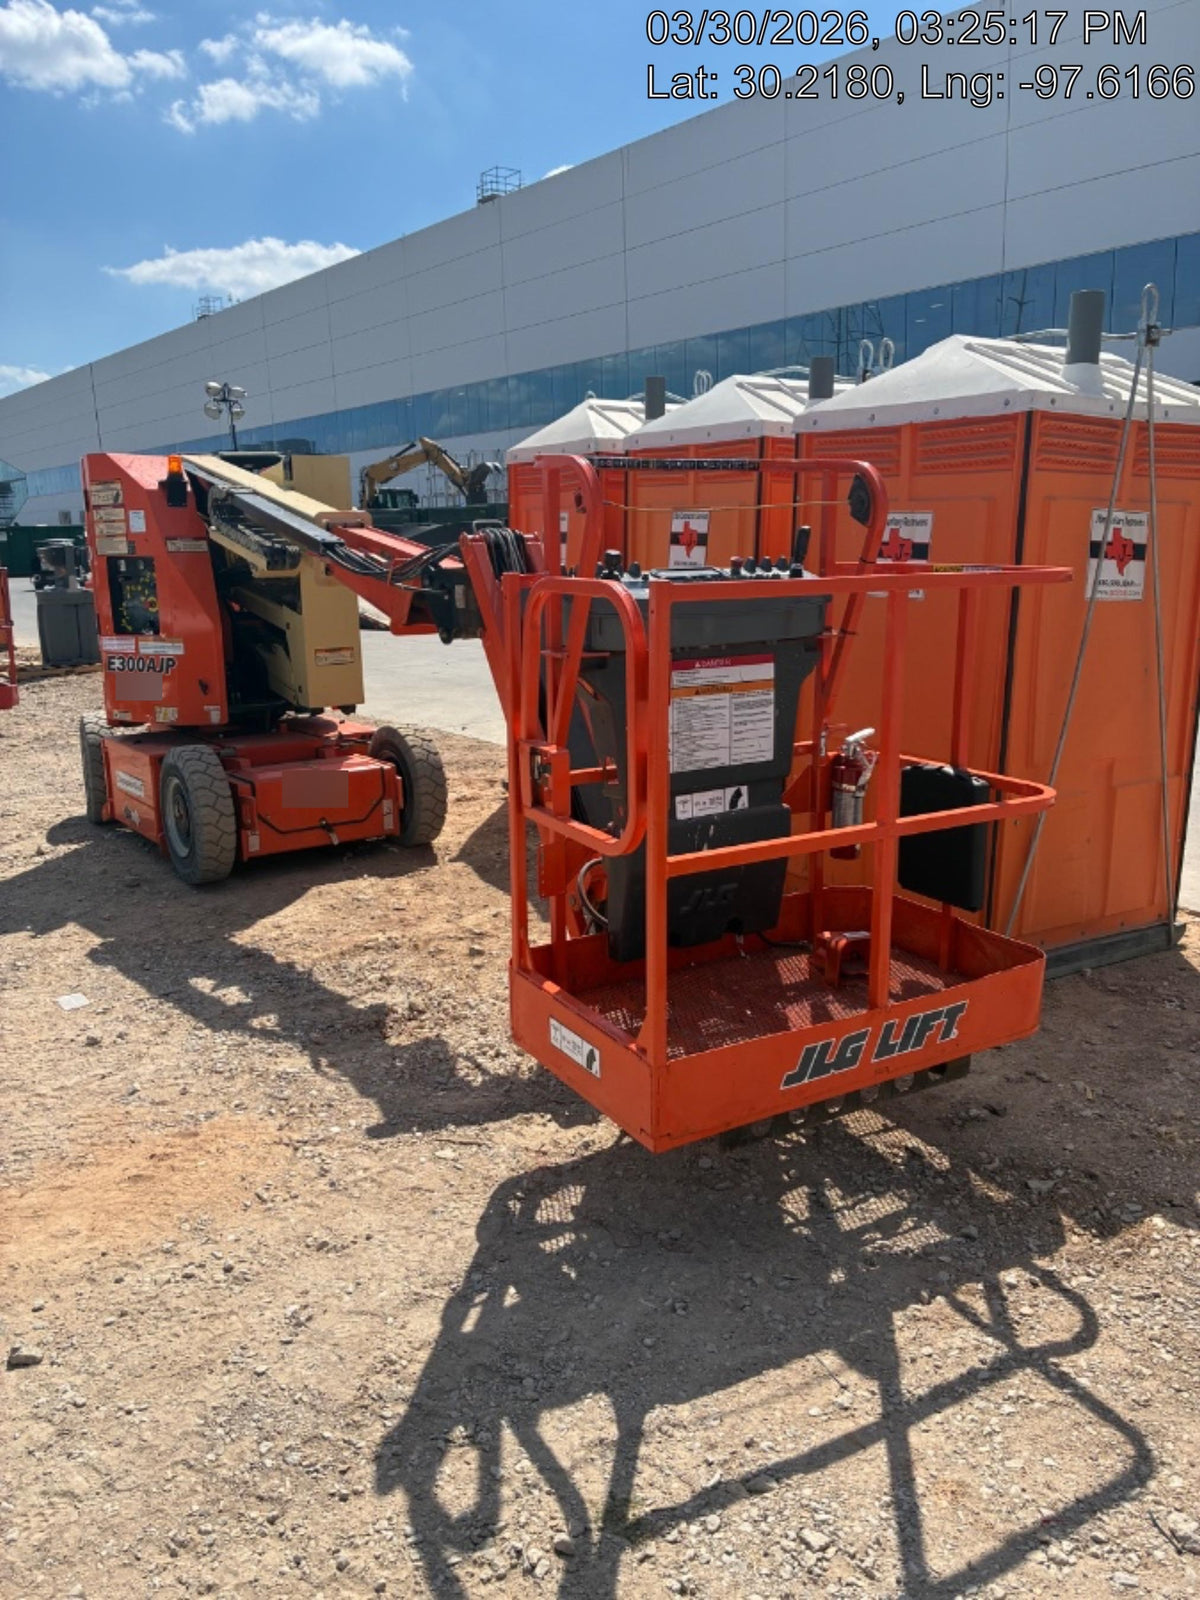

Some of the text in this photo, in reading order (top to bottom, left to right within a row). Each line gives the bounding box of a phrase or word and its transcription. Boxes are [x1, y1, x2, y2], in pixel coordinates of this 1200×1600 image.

[107, 656, 176, 674] E300AJP
[780, 1001, 968, 1090] JLG LIFT
